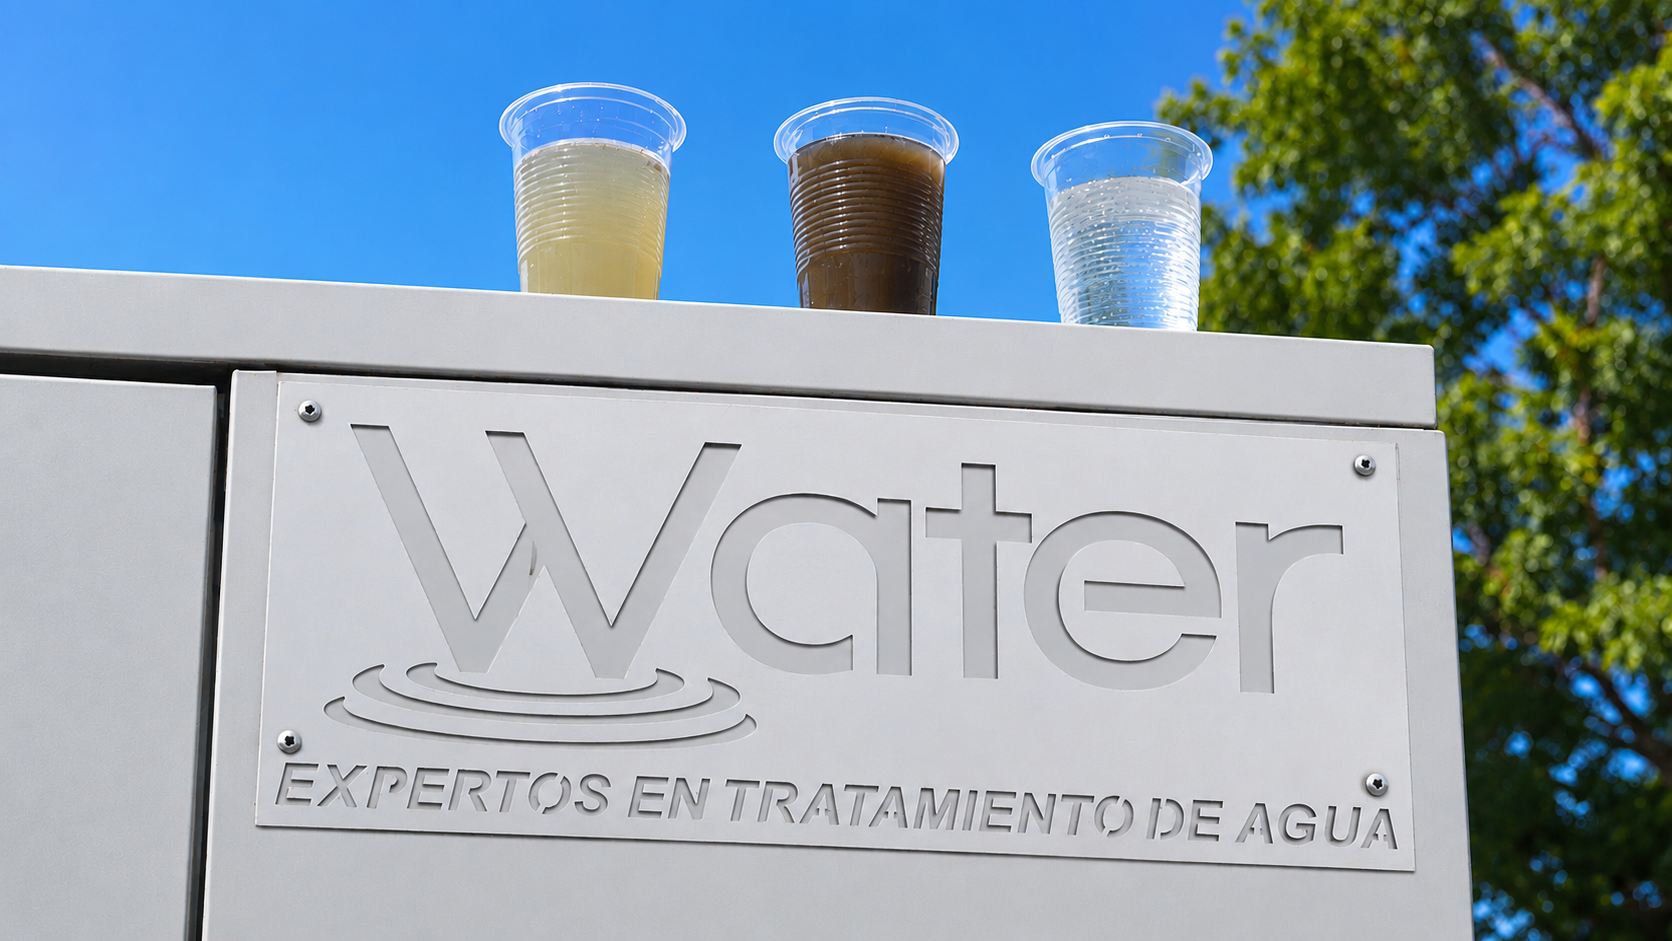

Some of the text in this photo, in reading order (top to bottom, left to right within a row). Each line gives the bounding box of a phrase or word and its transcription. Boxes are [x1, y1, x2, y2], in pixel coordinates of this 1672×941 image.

[350, 424, 1344, 693] Water
[275, 762, 1399, 850] EXPERTOS EN TRATAMIENTO DE AGUA
